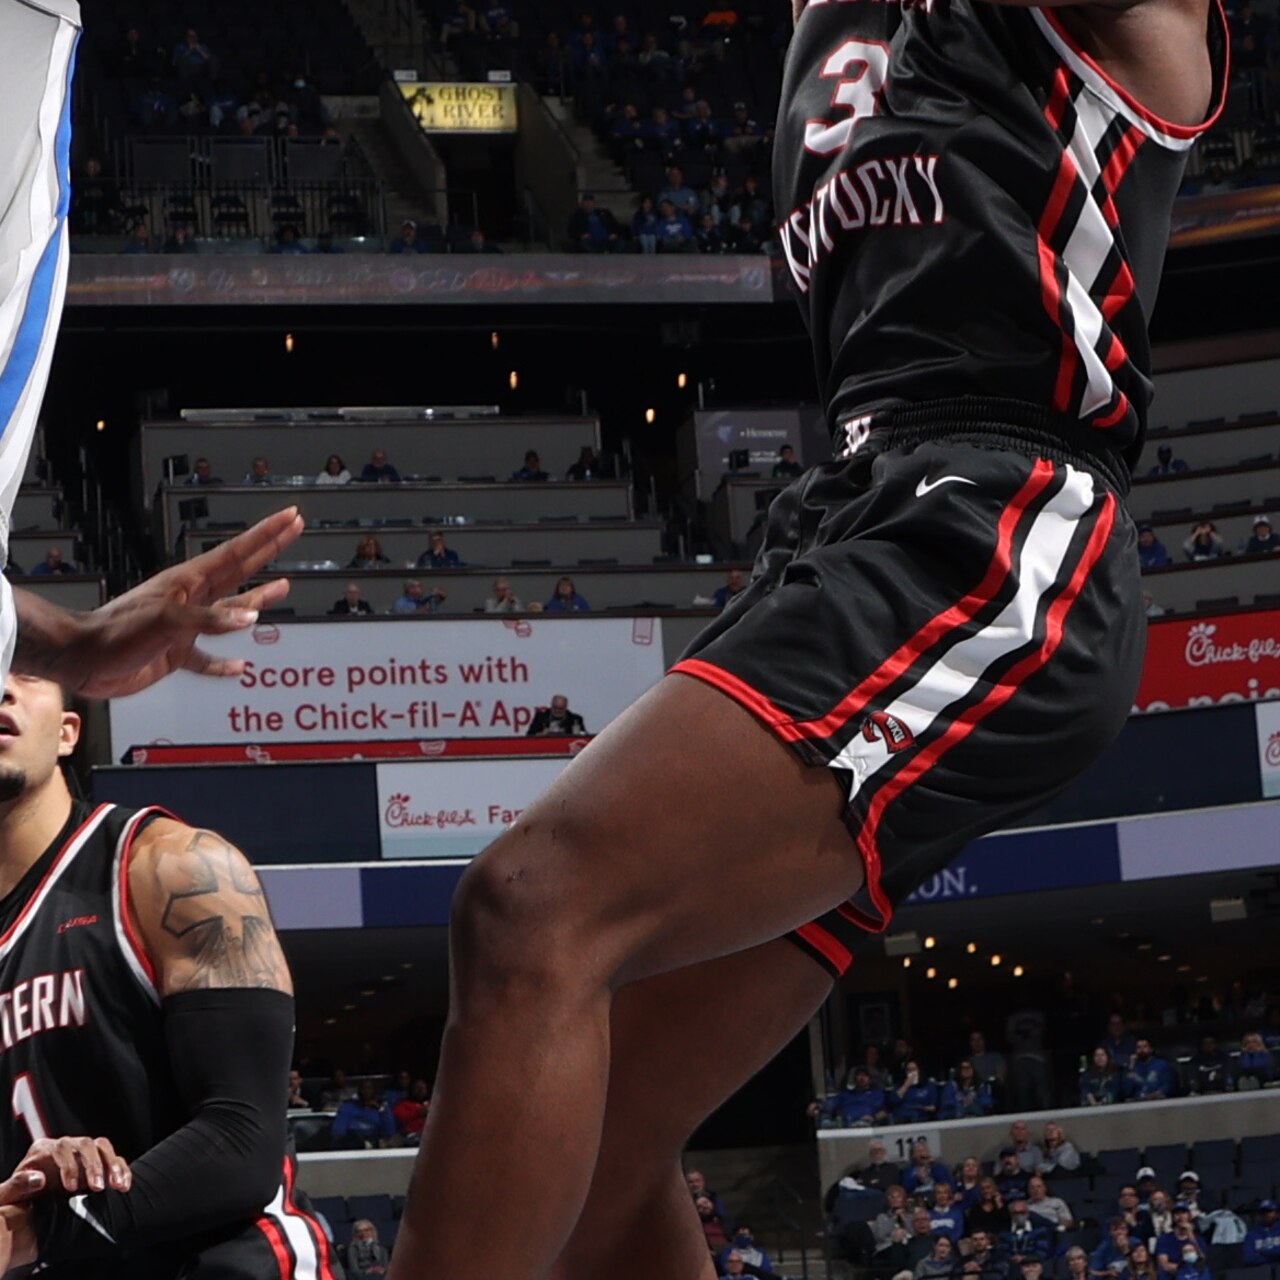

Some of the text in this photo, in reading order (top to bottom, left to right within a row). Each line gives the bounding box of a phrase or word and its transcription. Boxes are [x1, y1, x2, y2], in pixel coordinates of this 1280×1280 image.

[438, 86, 504, 102] GHOST
[804, 37, 891, 156] 3
[443, 104, 504, 119] RIVER
[239, 655, 529, 693] Score points with
[228, 704, 283, 732] the
[12, 1071, 50, 1142] 1
